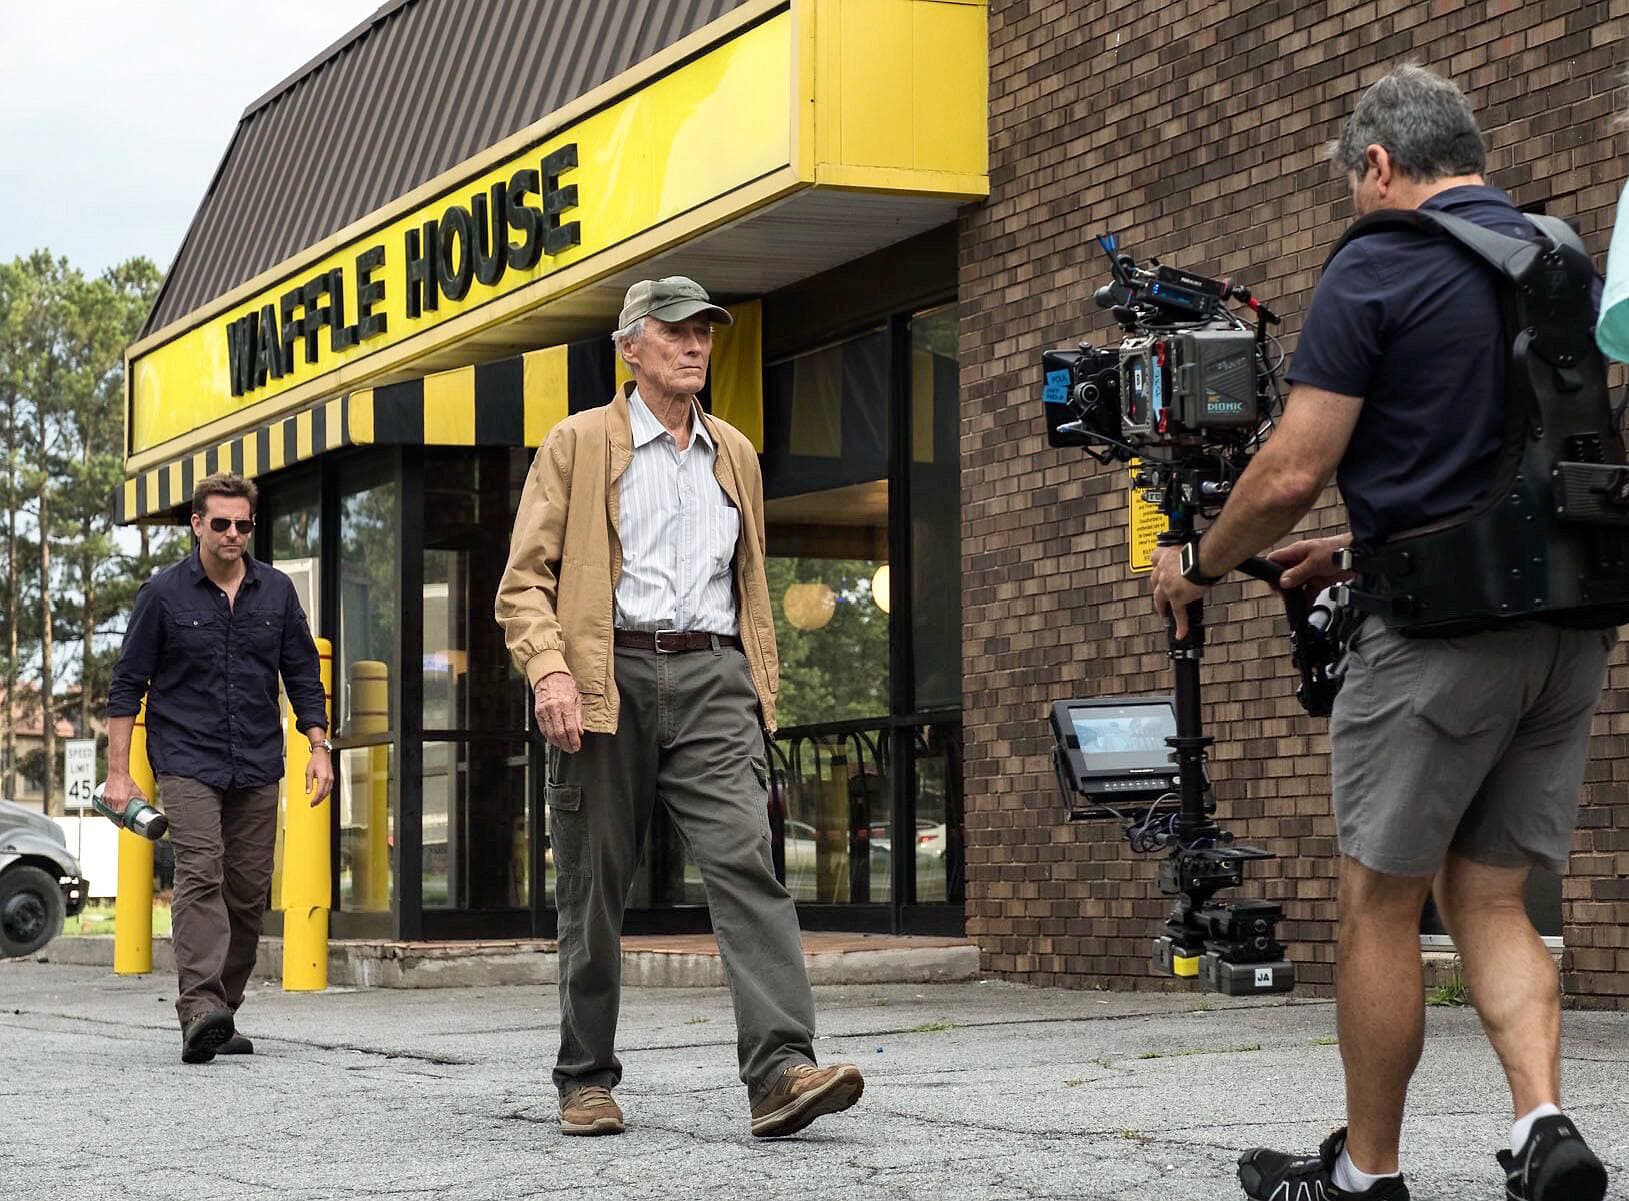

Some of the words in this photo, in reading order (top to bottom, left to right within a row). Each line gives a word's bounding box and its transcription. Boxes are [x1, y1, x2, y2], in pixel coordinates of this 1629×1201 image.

[226, 245, 387, 396] WAFFLE
[405, 143, 581, 319] HOUSE
[1208, 401, 1243, 411] DIONIC
[68, 748, 92, 759] SPEED
[70, 763, 90, 775] LIMIT
[69, 779, 91, 800] 45
[1258, 973, 1270, 982] JA
